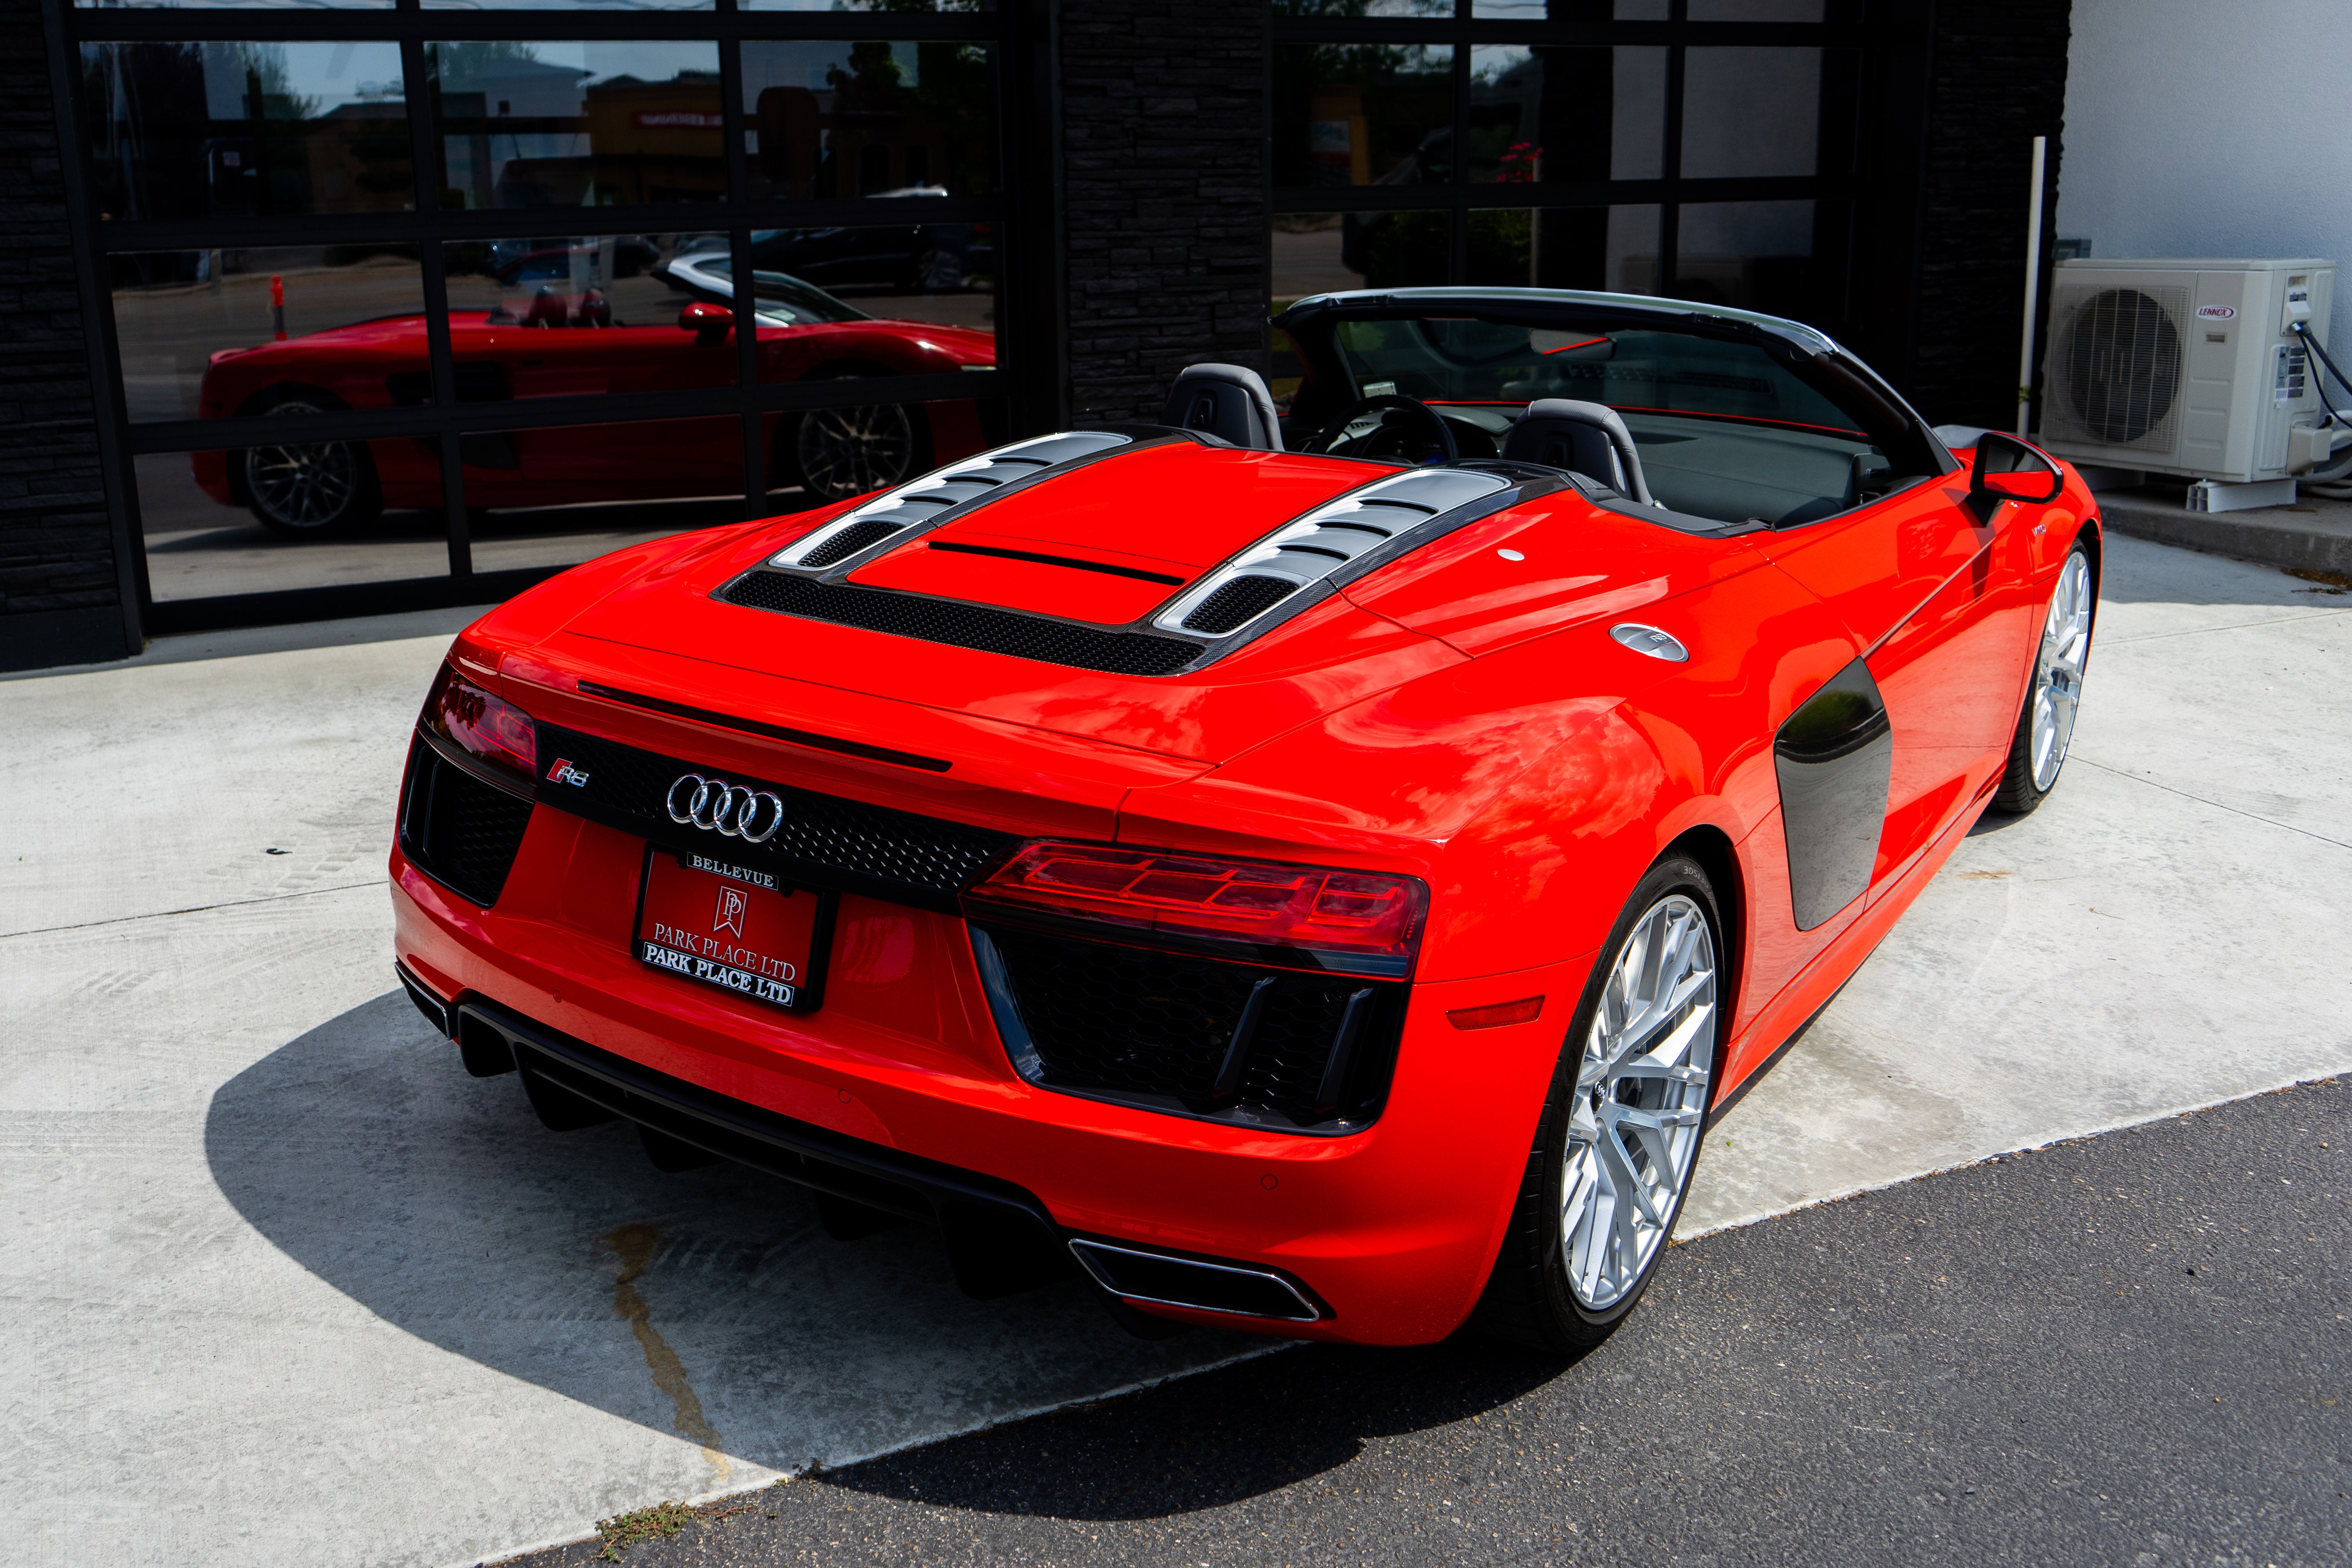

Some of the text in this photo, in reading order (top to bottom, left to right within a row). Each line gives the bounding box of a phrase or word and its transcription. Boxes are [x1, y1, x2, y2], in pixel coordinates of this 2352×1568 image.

[2199, 307, 2227, 316] LENNOX
[1649, 633, 1668, 643] R8
[556, 765, 589, 787] R8
[693, 855, 774, 887] BELLEVUE
[654, 923, 795, 981] PARK PLACE LTD
[646, 945, 791, 1003] PARK PLACE LTD
